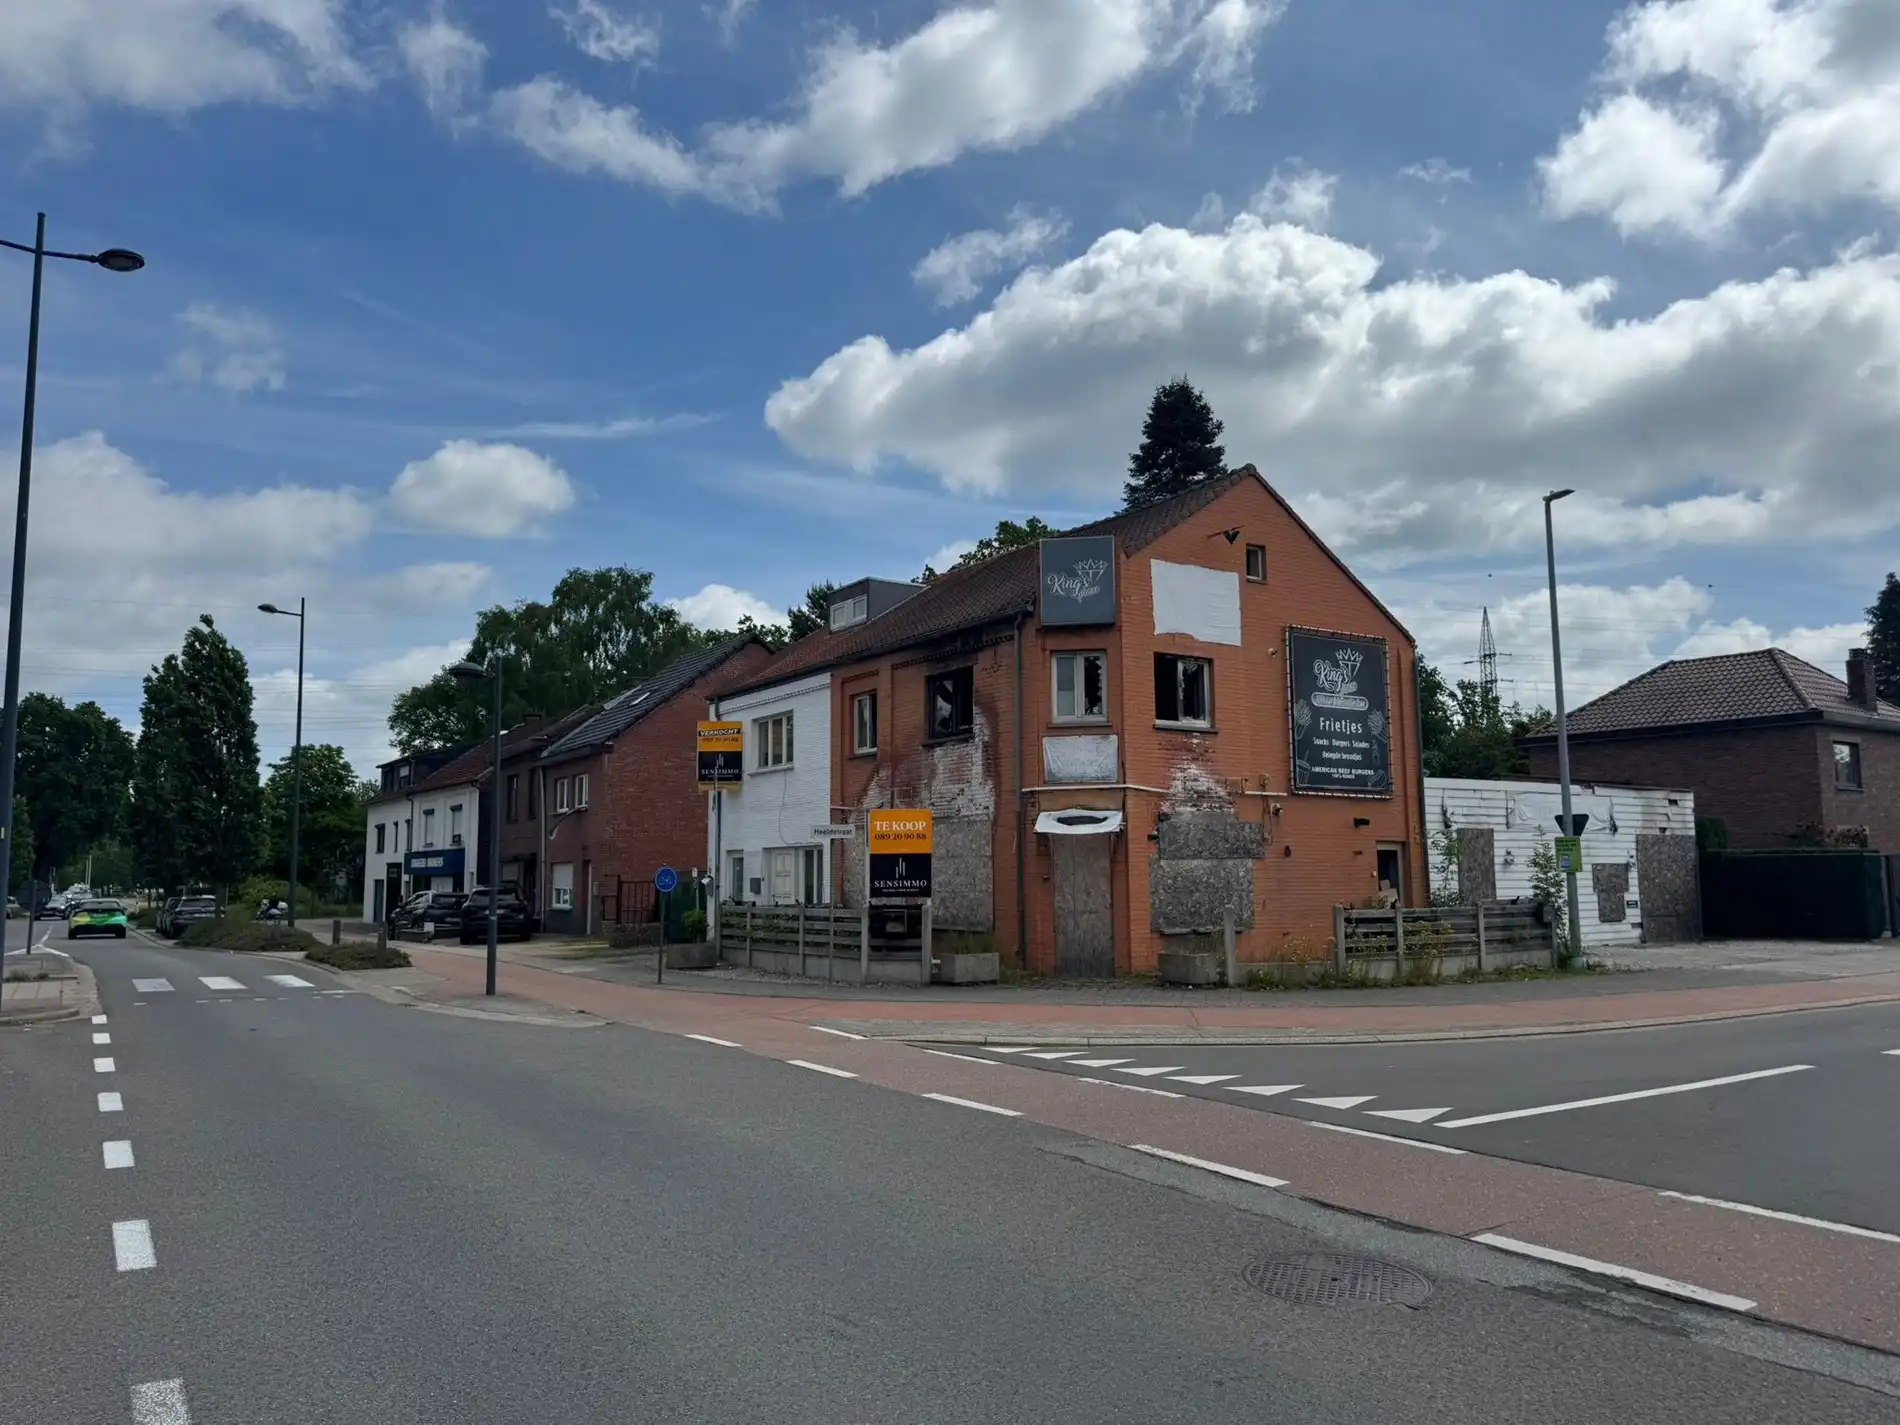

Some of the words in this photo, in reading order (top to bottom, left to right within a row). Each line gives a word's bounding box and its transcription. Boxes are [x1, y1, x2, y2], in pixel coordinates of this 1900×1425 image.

[1047, 573, 1090, 597] King's
[1314, 661, 1350, 692] King's
[1320, 717, 1362, 734] Frietjes
[875, 821, 890, 831] TE
[892, 821, 926, 831] KOOP
[874, 880, 927, 888] SENSIMMO
